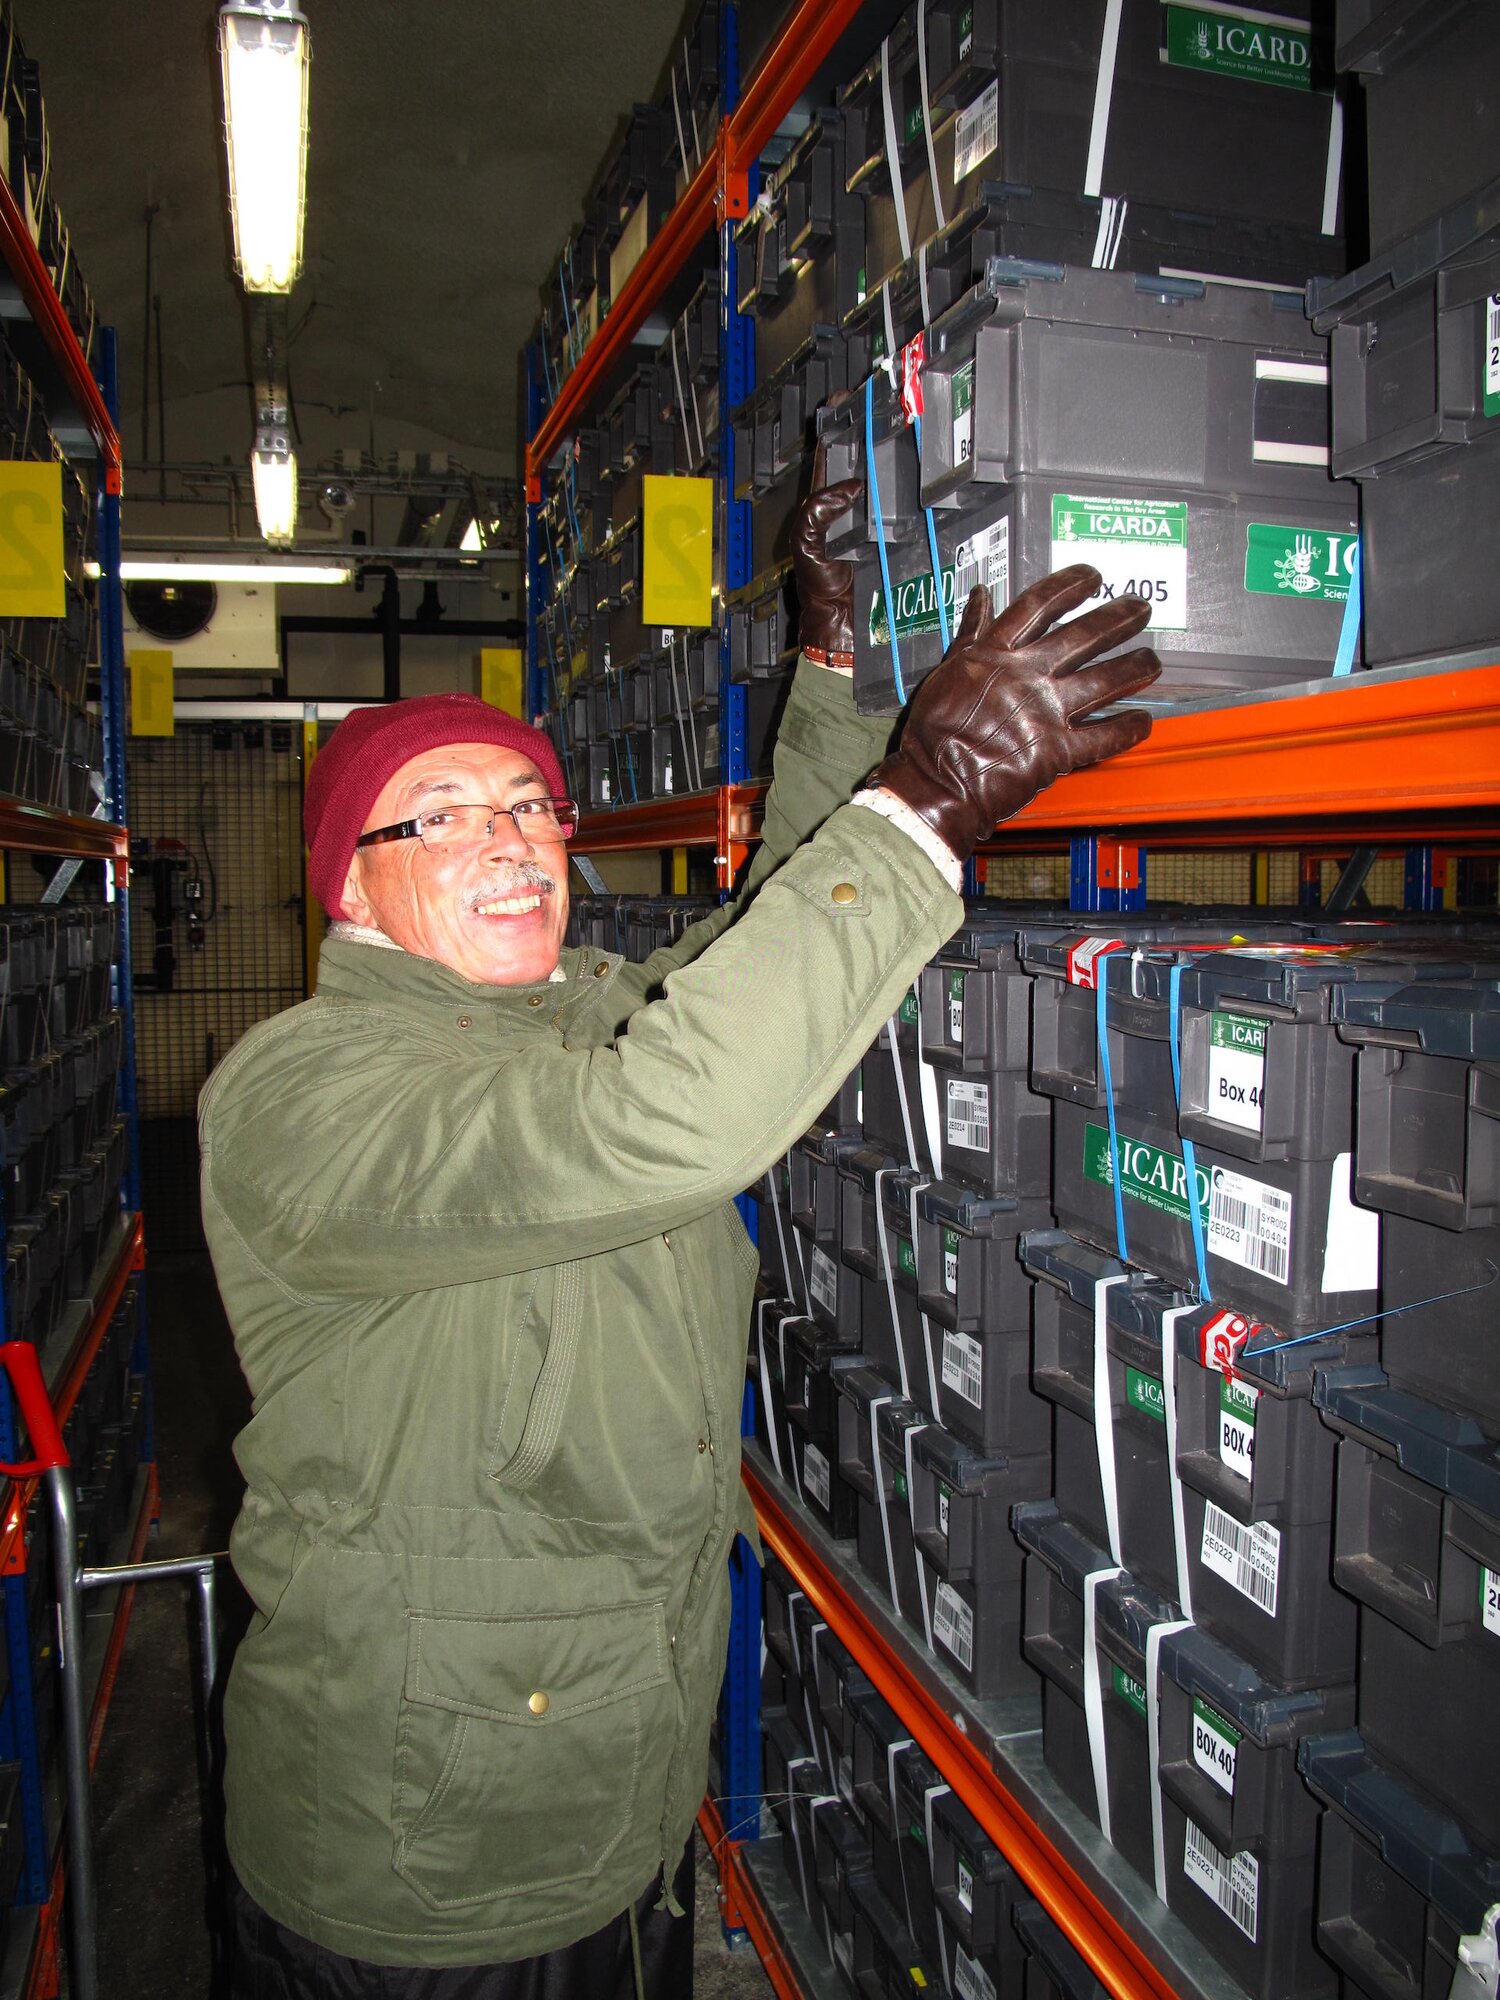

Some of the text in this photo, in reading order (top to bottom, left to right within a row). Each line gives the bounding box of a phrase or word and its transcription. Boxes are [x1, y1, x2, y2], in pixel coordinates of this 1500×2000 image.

[1216, 24, 1311, 68] ICARD
[1090, 514, 1172, 537] ICARDA
[896, 570, 955, 620] ICARD
[1124, 579, 1168, 602] 405
[953, 1008, 961, 1028] BO
[1220, 1077, 1245, 1104] Box
[1122, 1141, 1211, 1209] ICARD
[1163, 1201, 1191, 1220] Livelihood
[1261, 1212, 1288, 1231] SYR002
[1210, 1221, 1240, 1243] 2E0223
[1260, 1227, 1287, 1246] 00404
[1224, 1423, 1245, 1457] BOX
[1204, 1534, 1233, 1563] 2E0222
[1251, 1541, 1276, 1566] SYR002
[1250, 1554, 1275, 1581] 00403
[1196, 1726, 1217, 1763] BOX
[1186, 1846, 1215, 1881] 2E0221
[1231, 1877, 1256, 1907] 00402
[1232, 1864, 1256, 1894] SYR002
